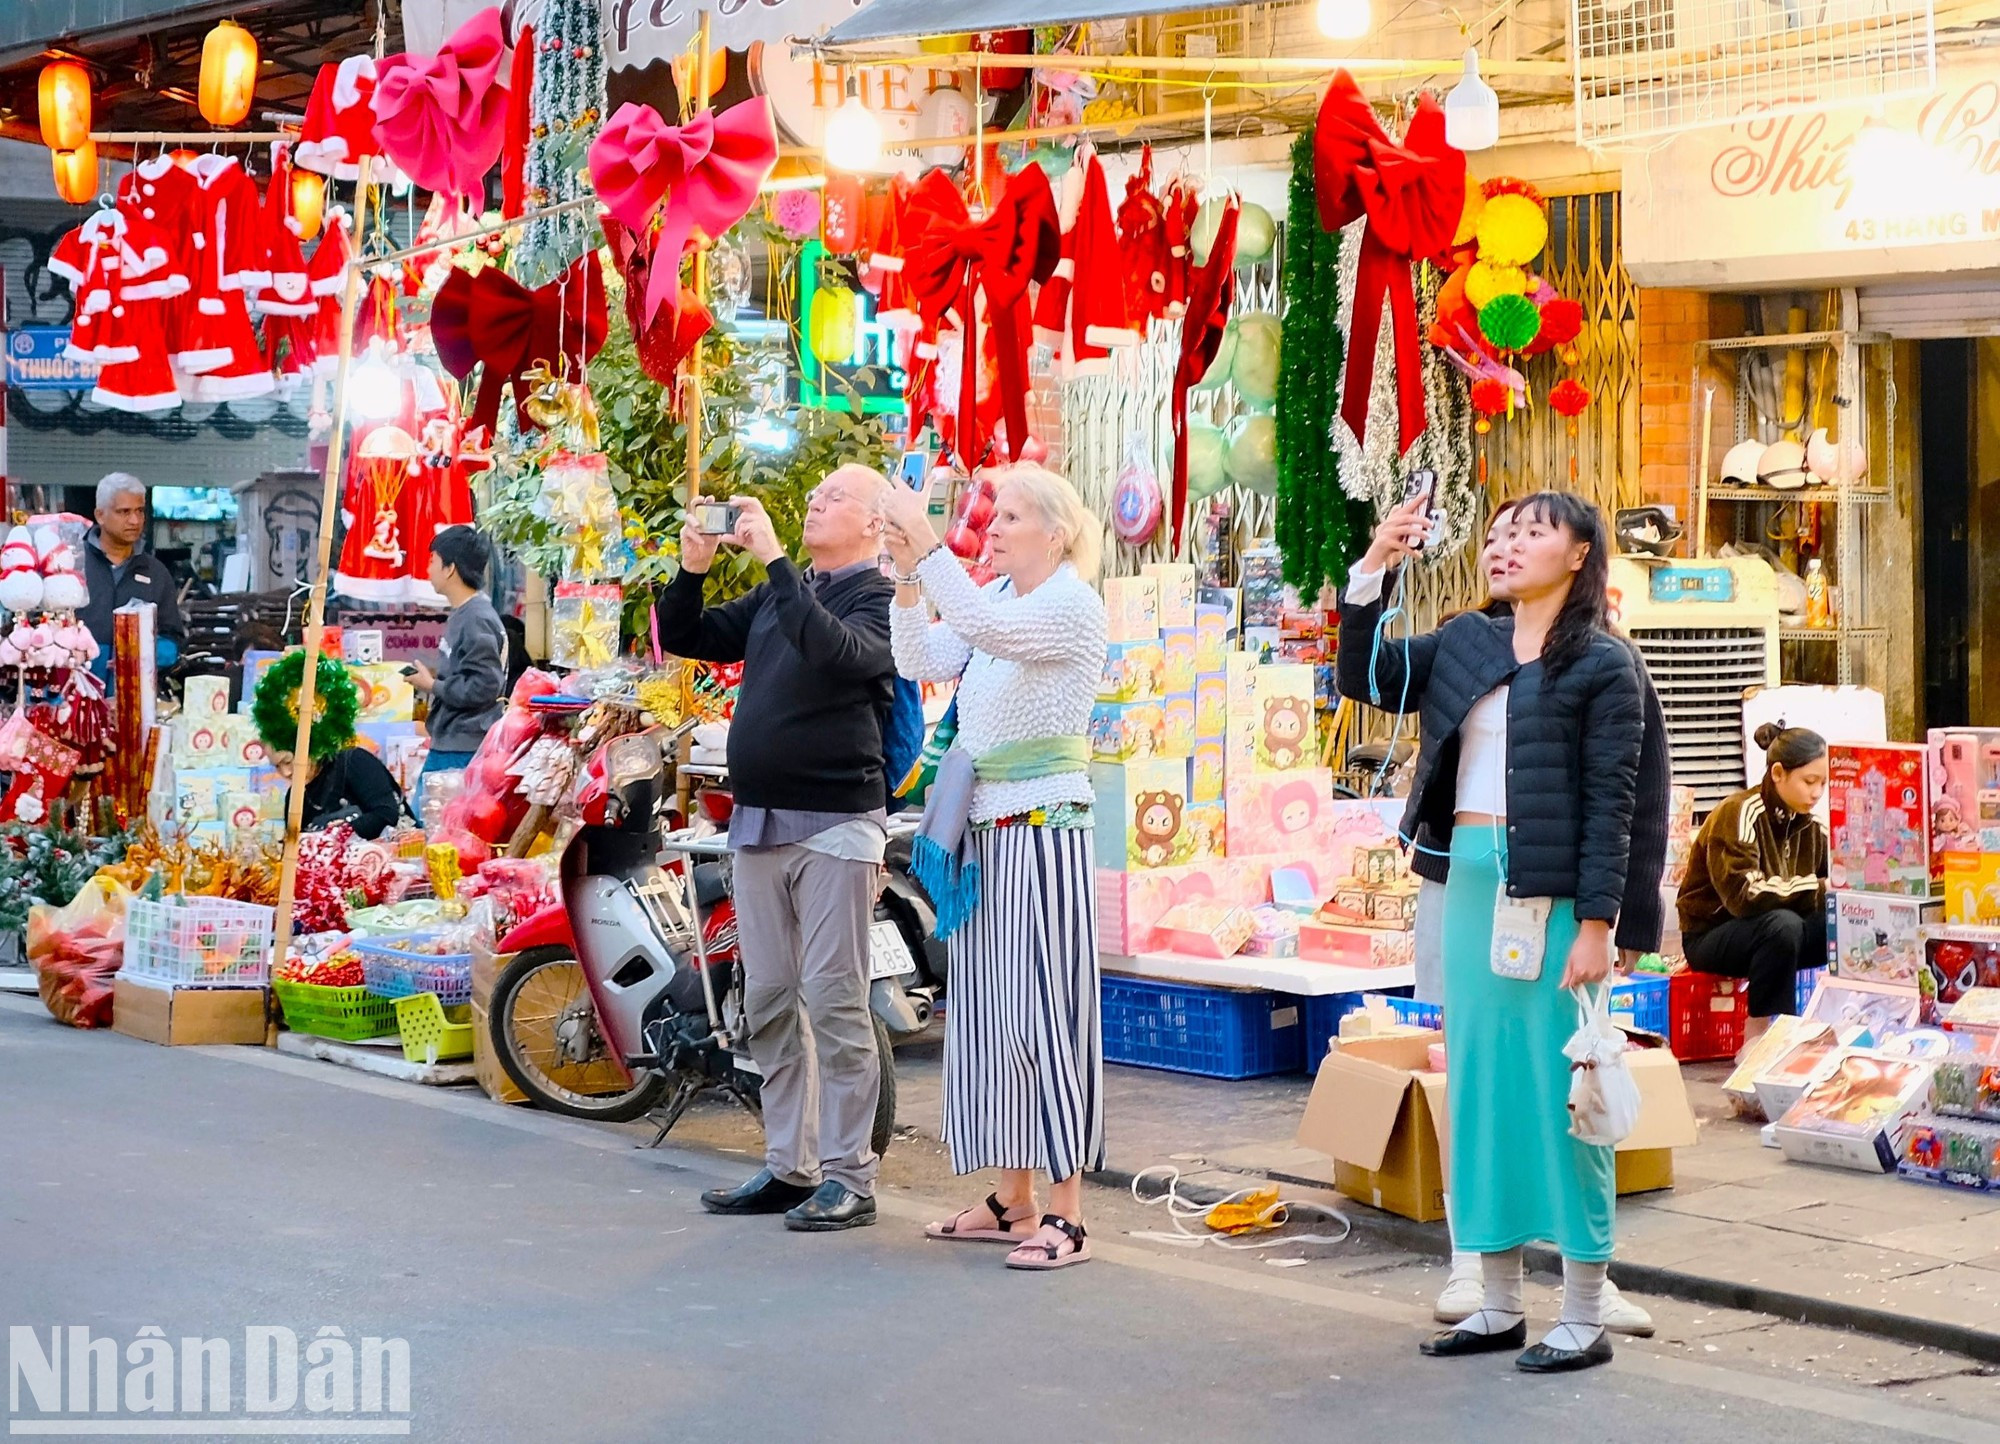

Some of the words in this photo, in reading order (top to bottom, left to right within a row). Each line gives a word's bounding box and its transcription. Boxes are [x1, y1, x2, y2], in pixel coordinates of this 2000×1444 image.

[1845, 219, 1876, 241] 43
[1841, 902, 1875, 919] Kitchen
[591, 918, 621, 927] HONDA
